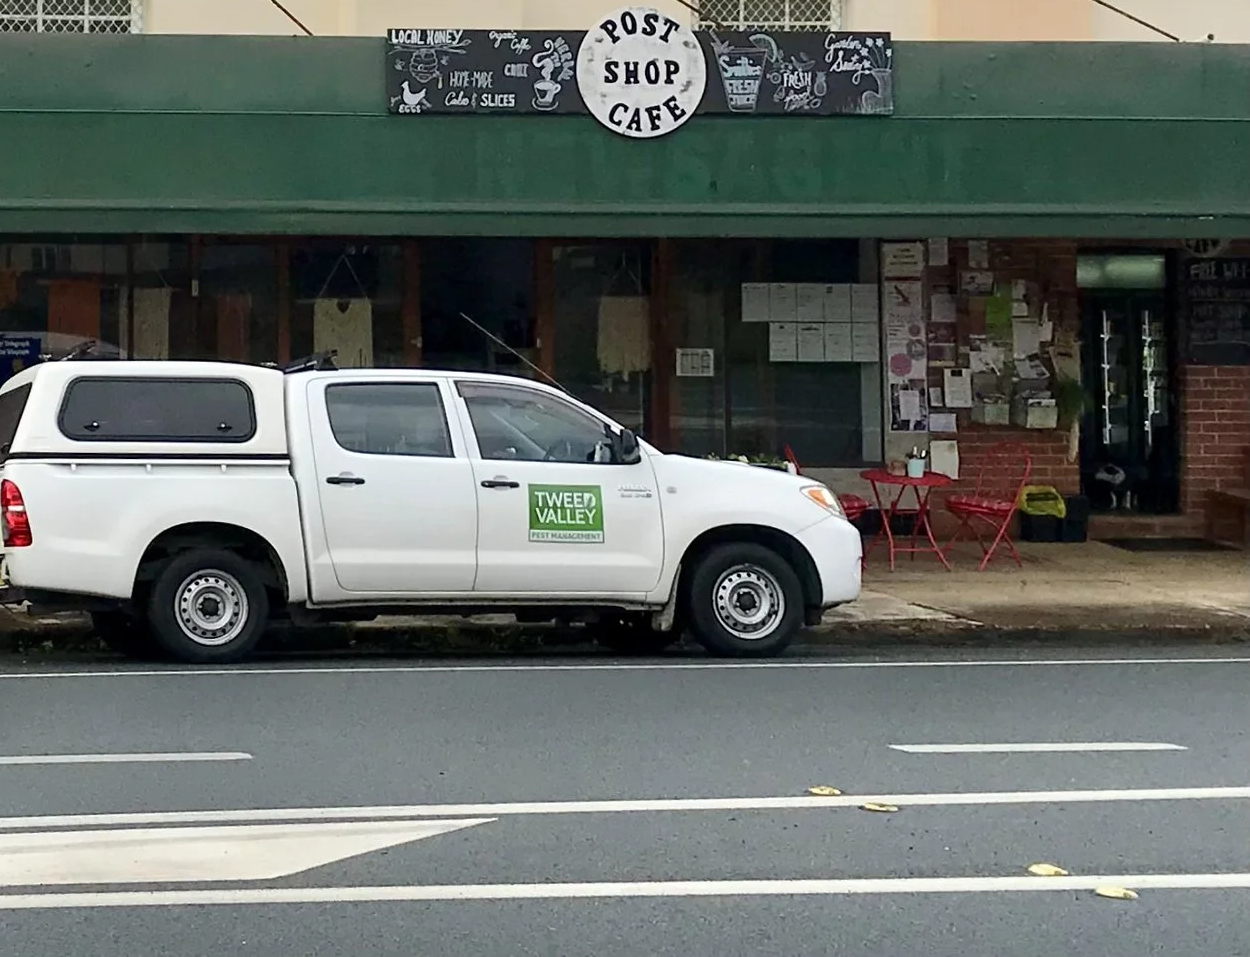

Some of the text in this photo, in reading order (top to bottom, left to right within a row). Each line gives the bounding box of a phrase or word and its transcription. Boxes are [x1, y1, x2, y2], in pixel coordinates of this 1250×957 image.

[600, 10, 681, 45] POST
[391, 29, 464, 45] LOCAL HONEY
[604, 59, 681, 85] SHOP
[783, 68, 812, 90] FRESH
[398, 104, 421, 114] EGGS
[480, 93, 516, 108] SLICES
[608, 95, 687, 132] CAFE
[534, 491, 597, 508] TWEED
[534, 507, 597, 524] VALLEY
[551, 532, 602, 540] MANAGEMENT
